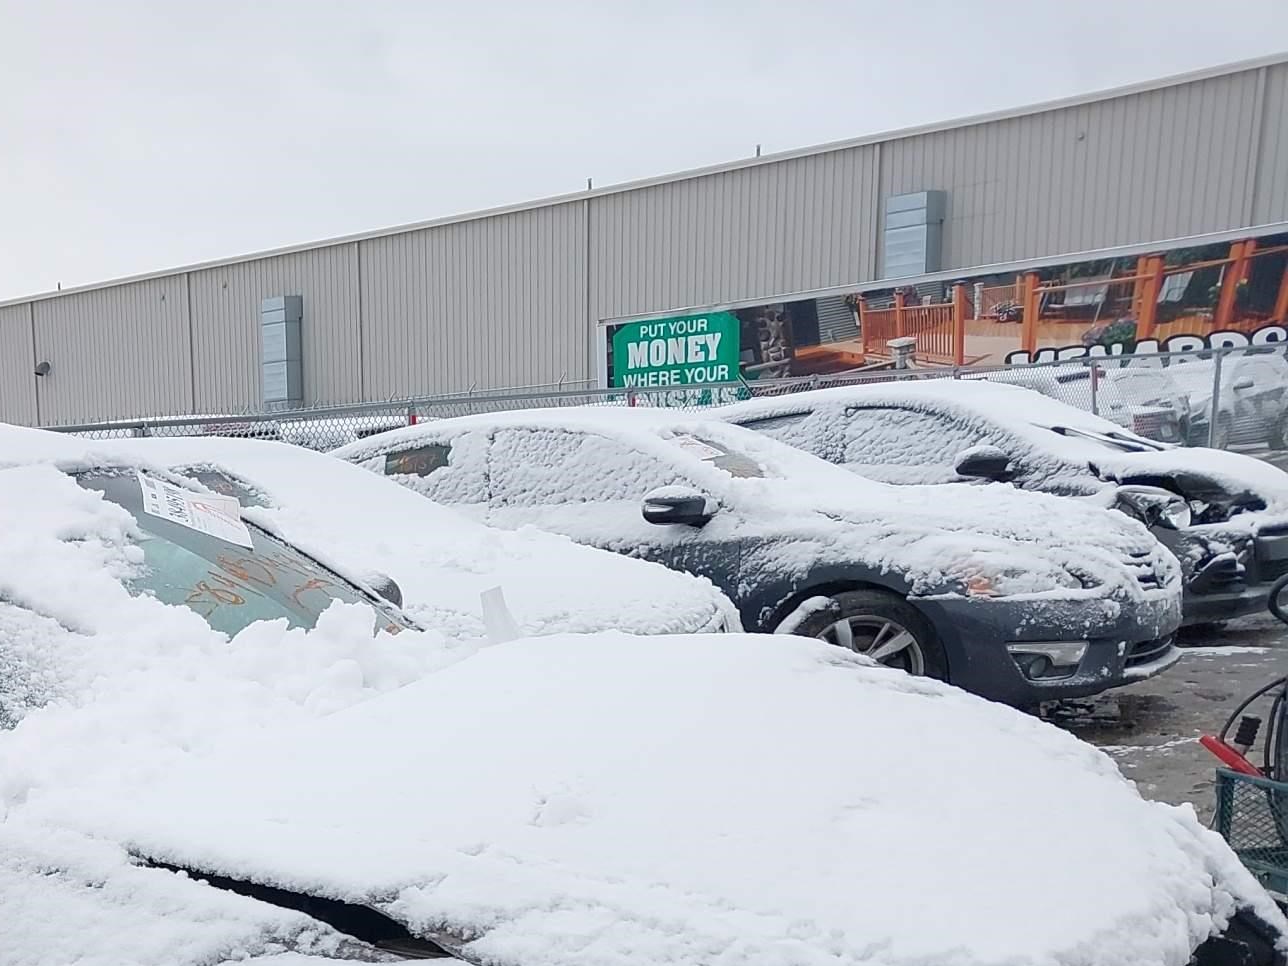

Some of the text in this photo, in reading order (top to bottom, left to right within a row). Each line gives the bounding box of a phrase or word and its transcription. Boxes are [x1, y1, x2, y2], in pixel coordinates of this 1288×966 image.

[640, 318, 708, 338] PUT YOUR
[627, 332, 722, 370] MONEY
[623, 364, 729, 388] WHERE YOUR
